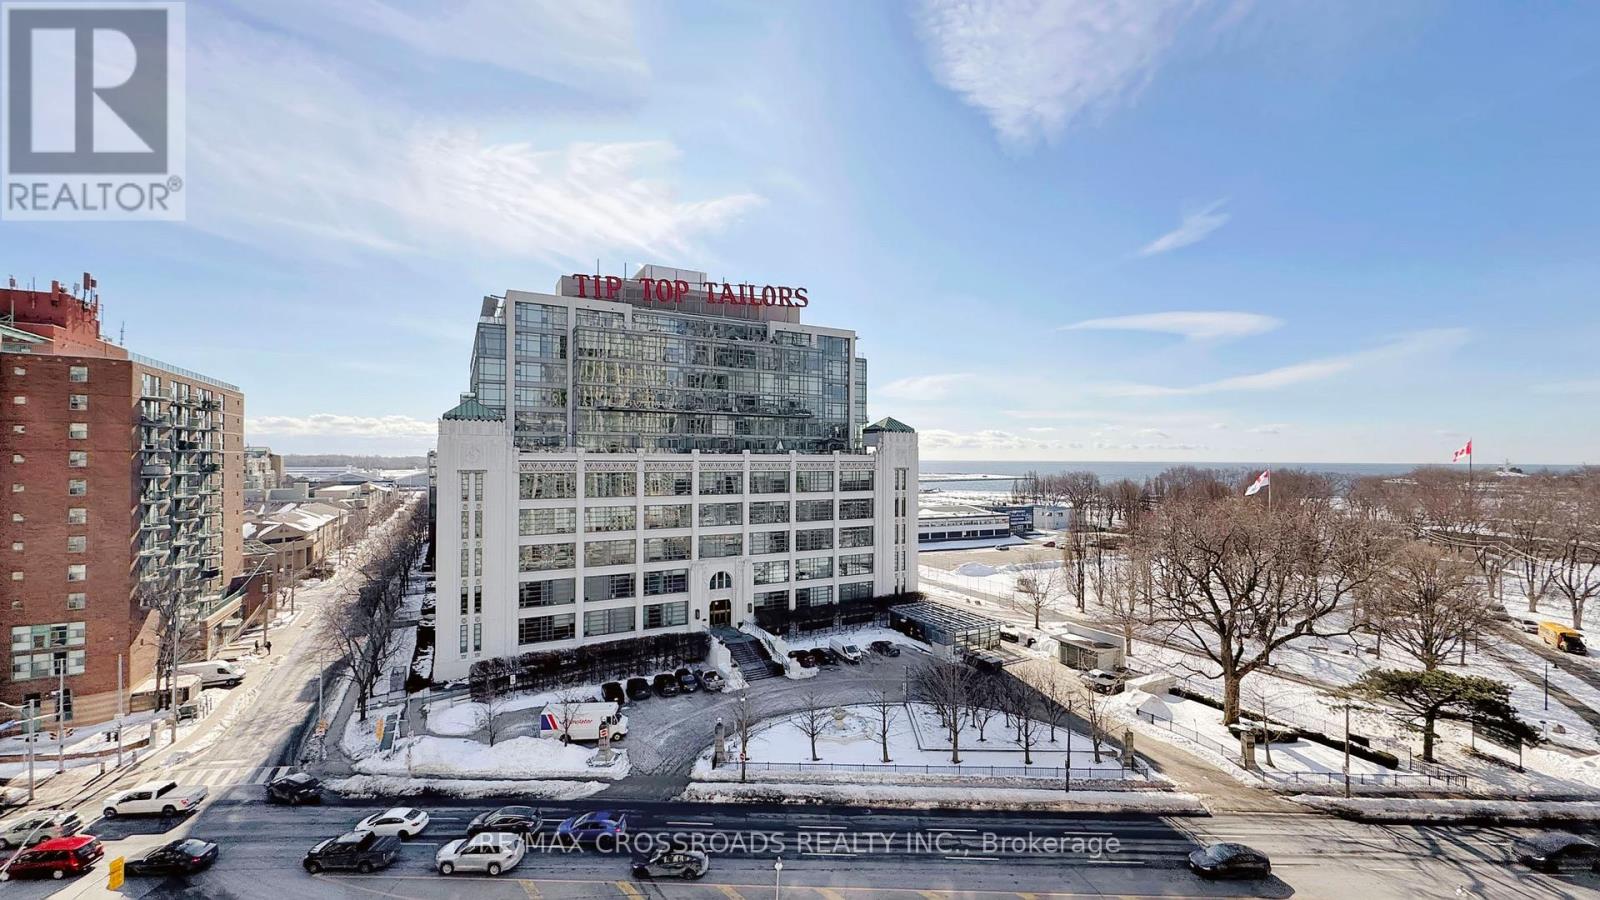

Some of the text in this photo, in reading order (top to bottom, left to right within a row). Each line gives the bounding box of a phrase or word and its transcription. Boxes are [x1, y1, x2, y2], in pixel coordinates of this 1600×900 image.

[573, 273, 809, 308] TIP TOP TAILORS
